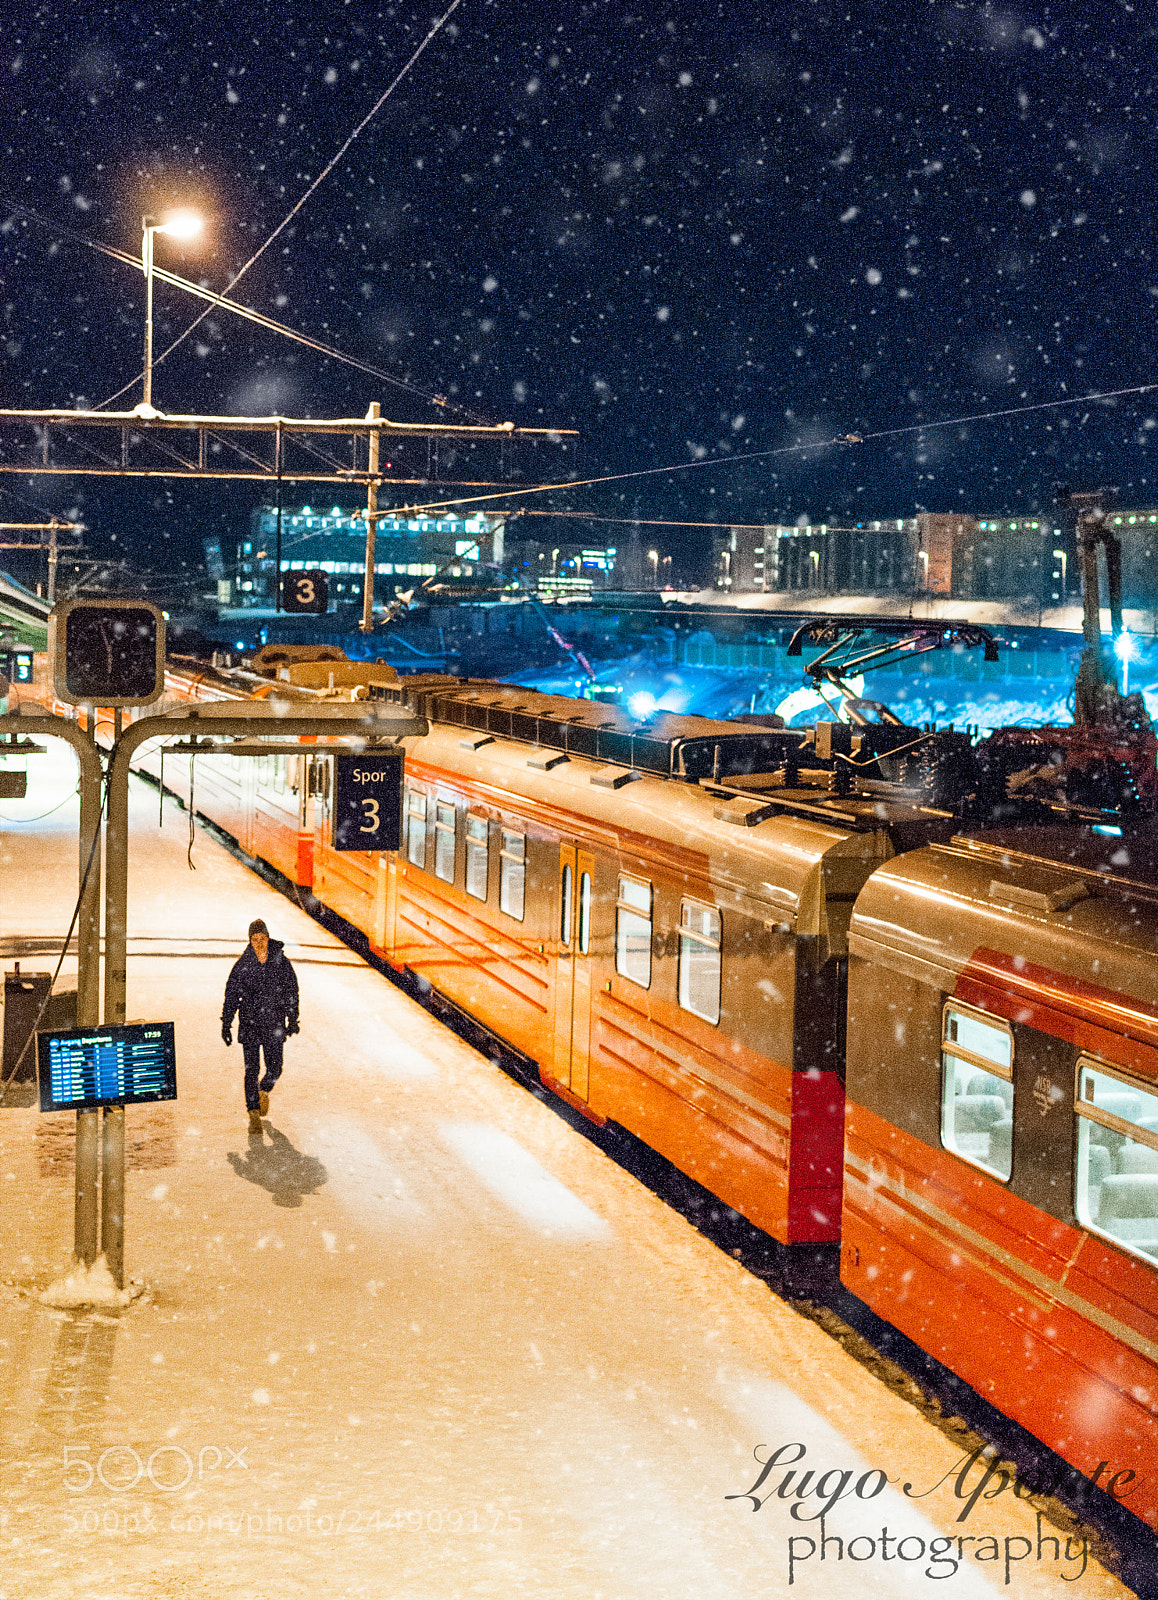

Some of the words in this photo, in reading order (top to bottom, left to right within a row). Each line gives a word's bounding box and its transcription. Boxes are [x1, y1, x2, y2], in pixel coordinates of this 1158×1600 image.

[296, 579, 315, 604] 3
[18, 665, 29, 679] 3
[352, 768, 387, 786] Spor
[359, 798, 380, 833] 3
